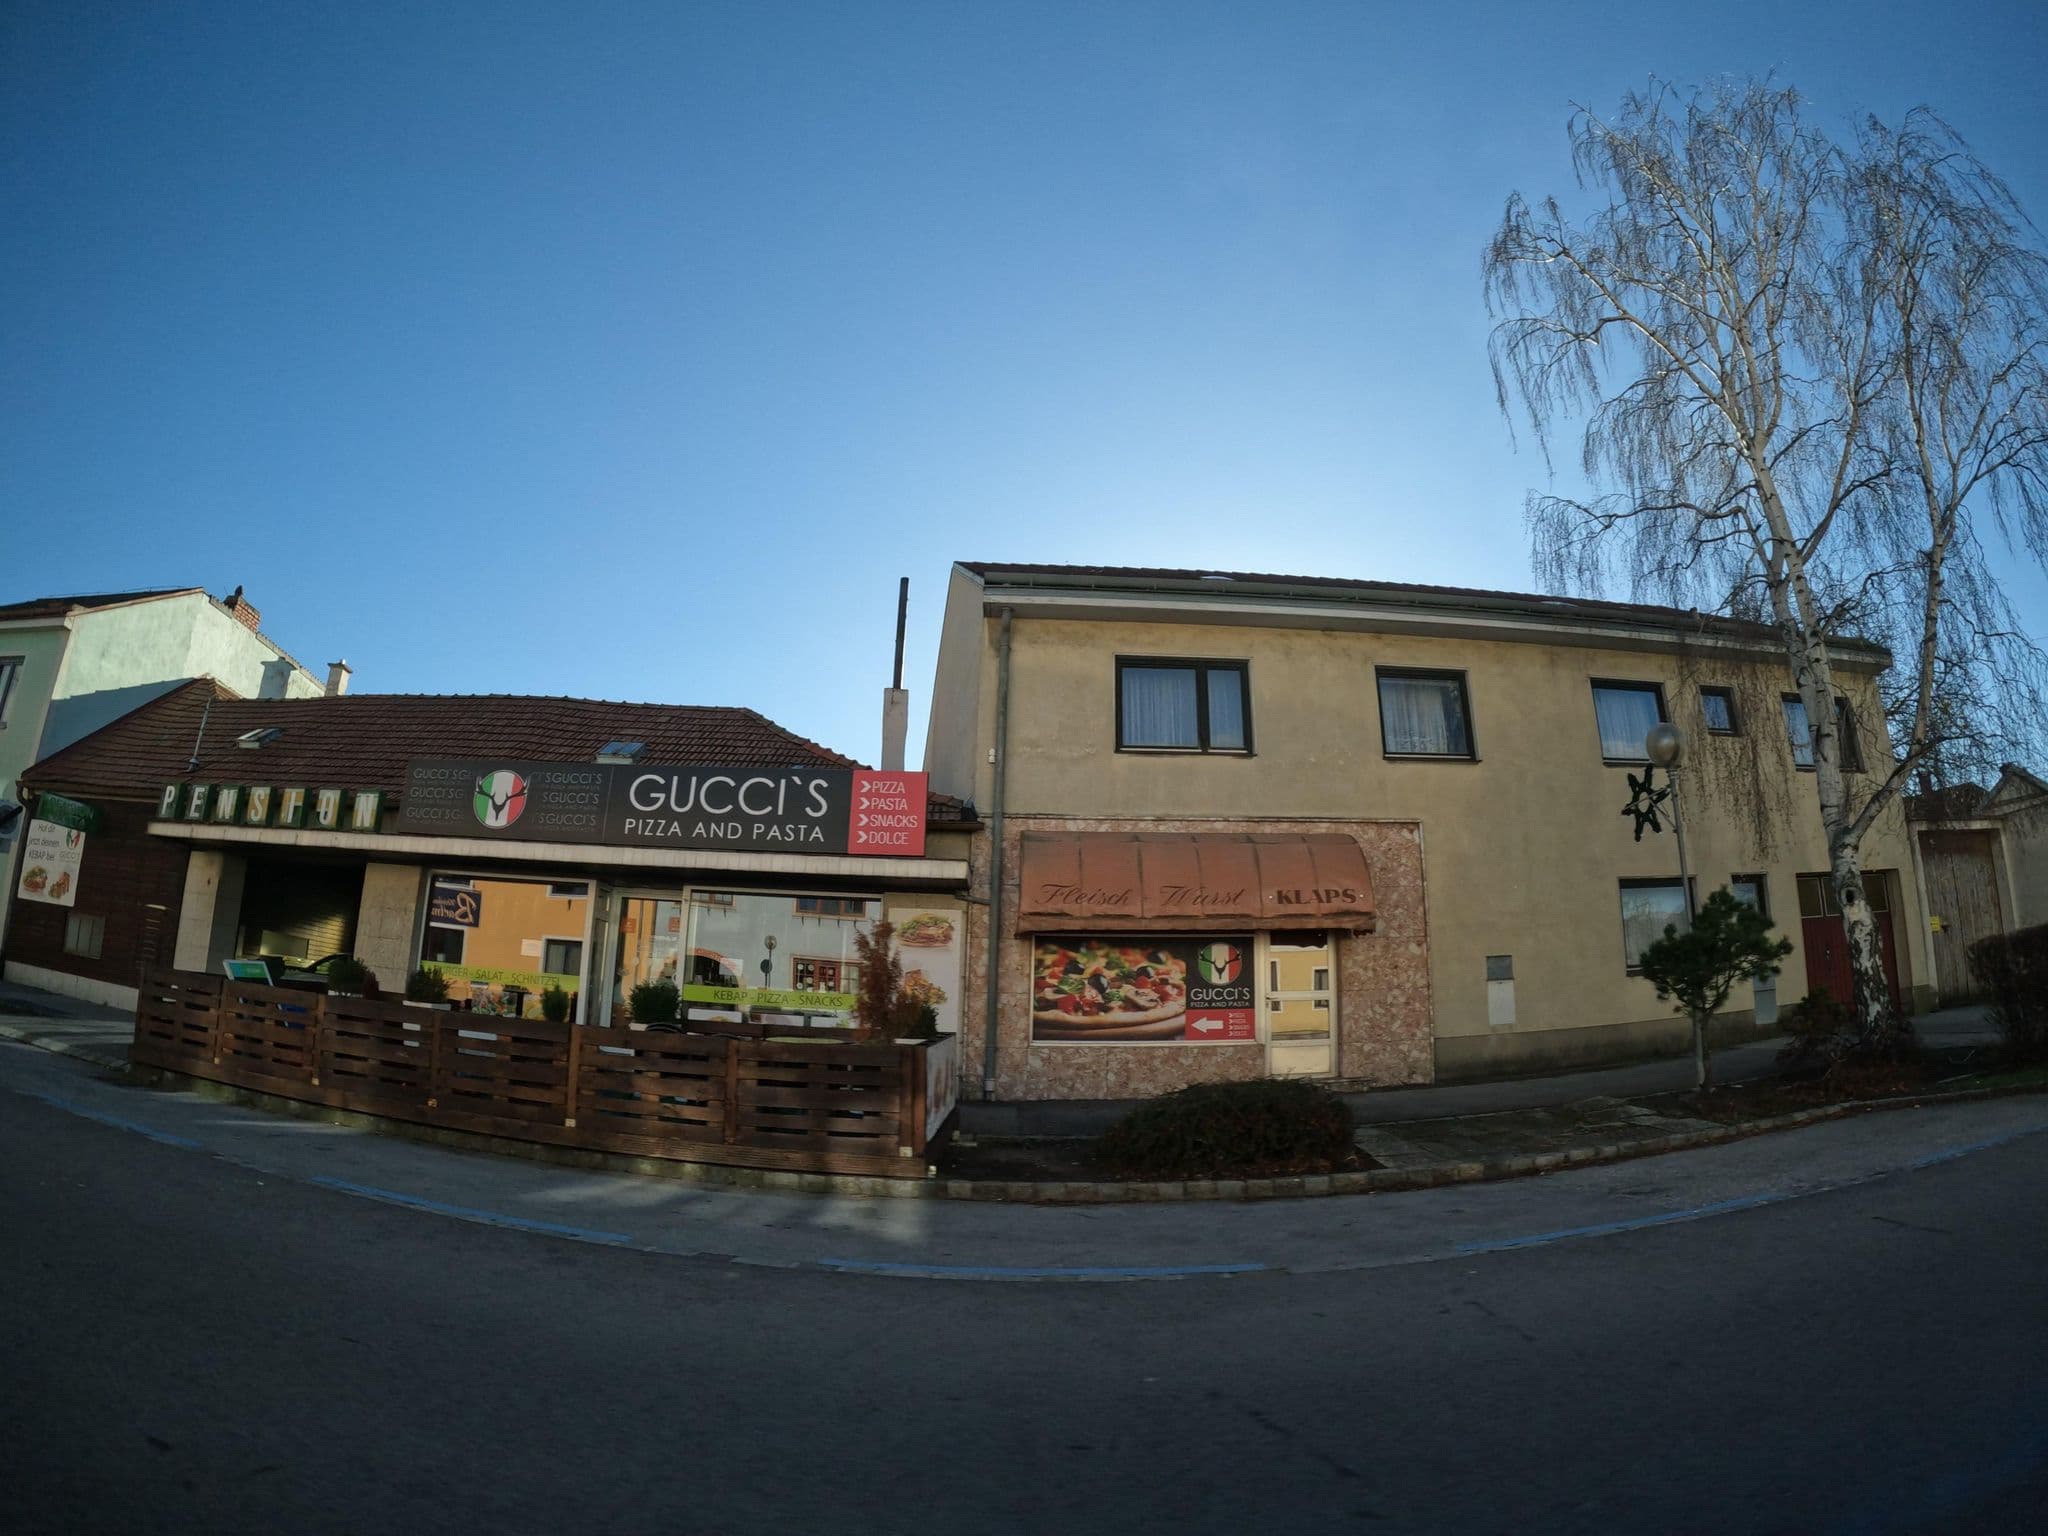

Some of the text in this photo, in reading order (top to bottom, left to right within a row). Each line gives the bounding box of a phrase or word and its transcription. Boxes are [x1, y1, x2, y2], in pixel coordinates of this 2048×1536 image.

[871, 780, 905, 794] PIZZA
[159, 784, 379, 828] PENSION
[870, 797, 908, 811] PASTA
[868, 814, 919, 828] SNACKS
[624, 818, 825, 842] PIZZA AND PASTA
[868, 830, 910, 845] DOLCE
[1034, 883, 1134, 906] Fleisch
[1158, 884, 1247, 907] Wurst
[1276, 888, 1357, 905] KLAPS
[475, 969, 504, 981] SALAT
[713, 989, 748, 1002] KEBAP
[756, 992, 789, 1005] PIZZA
[798, 994, 844, 1007] SNACKS
